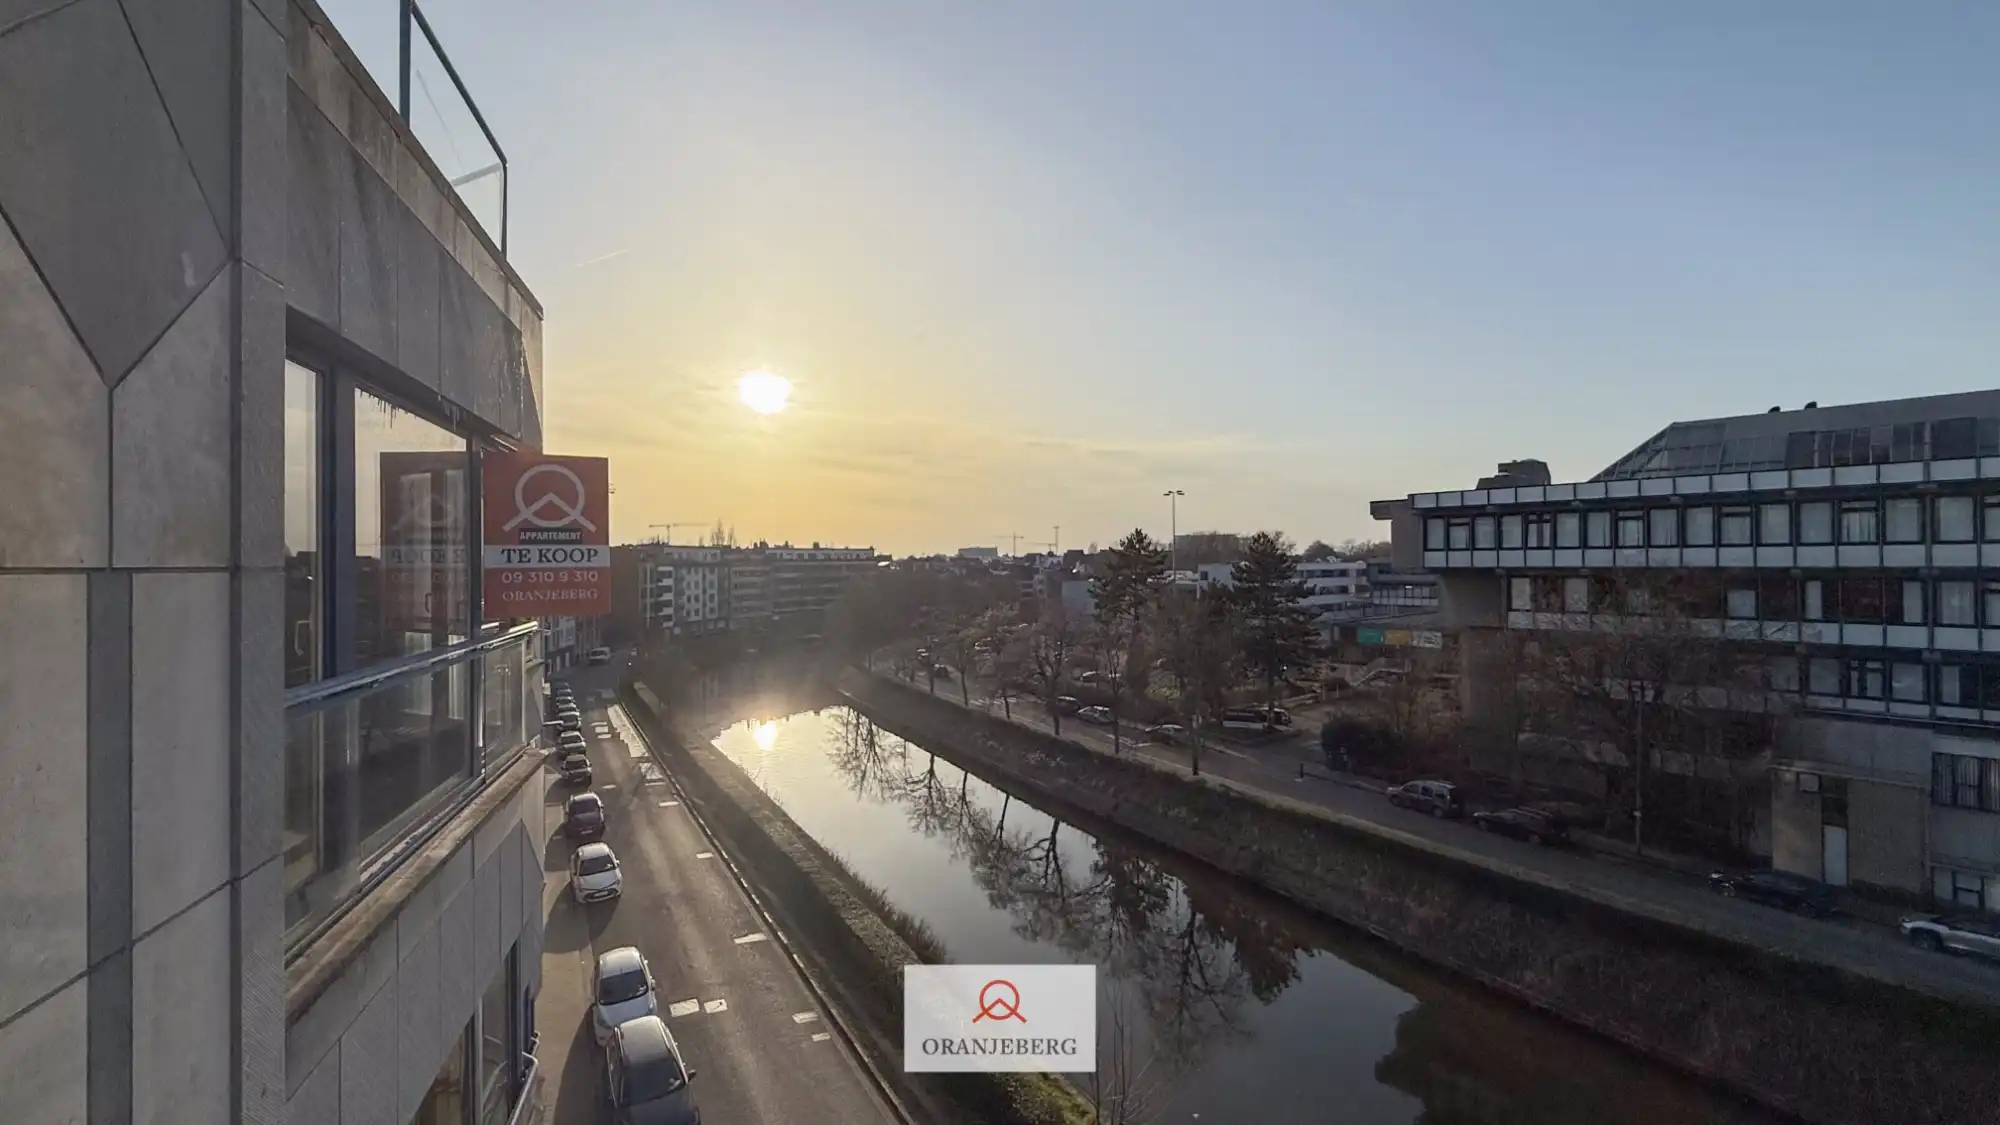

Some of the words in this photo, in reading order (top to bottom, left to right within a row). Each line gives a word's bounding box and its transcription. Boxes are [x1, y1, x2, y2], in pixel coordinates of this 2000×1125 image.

[520, 531, 582, 541] APPARTEMENT
[501, 547, 532, 564] TE
[537, 547, 599, 564] KOOP
[501, 571, 523, 584] 09
[528, 571, 554, 584] 310
[559, 571, 569, 583] 9
[573, 570, 599, 583] 310
[501, 588, 599, 602] ORANJEBERG
